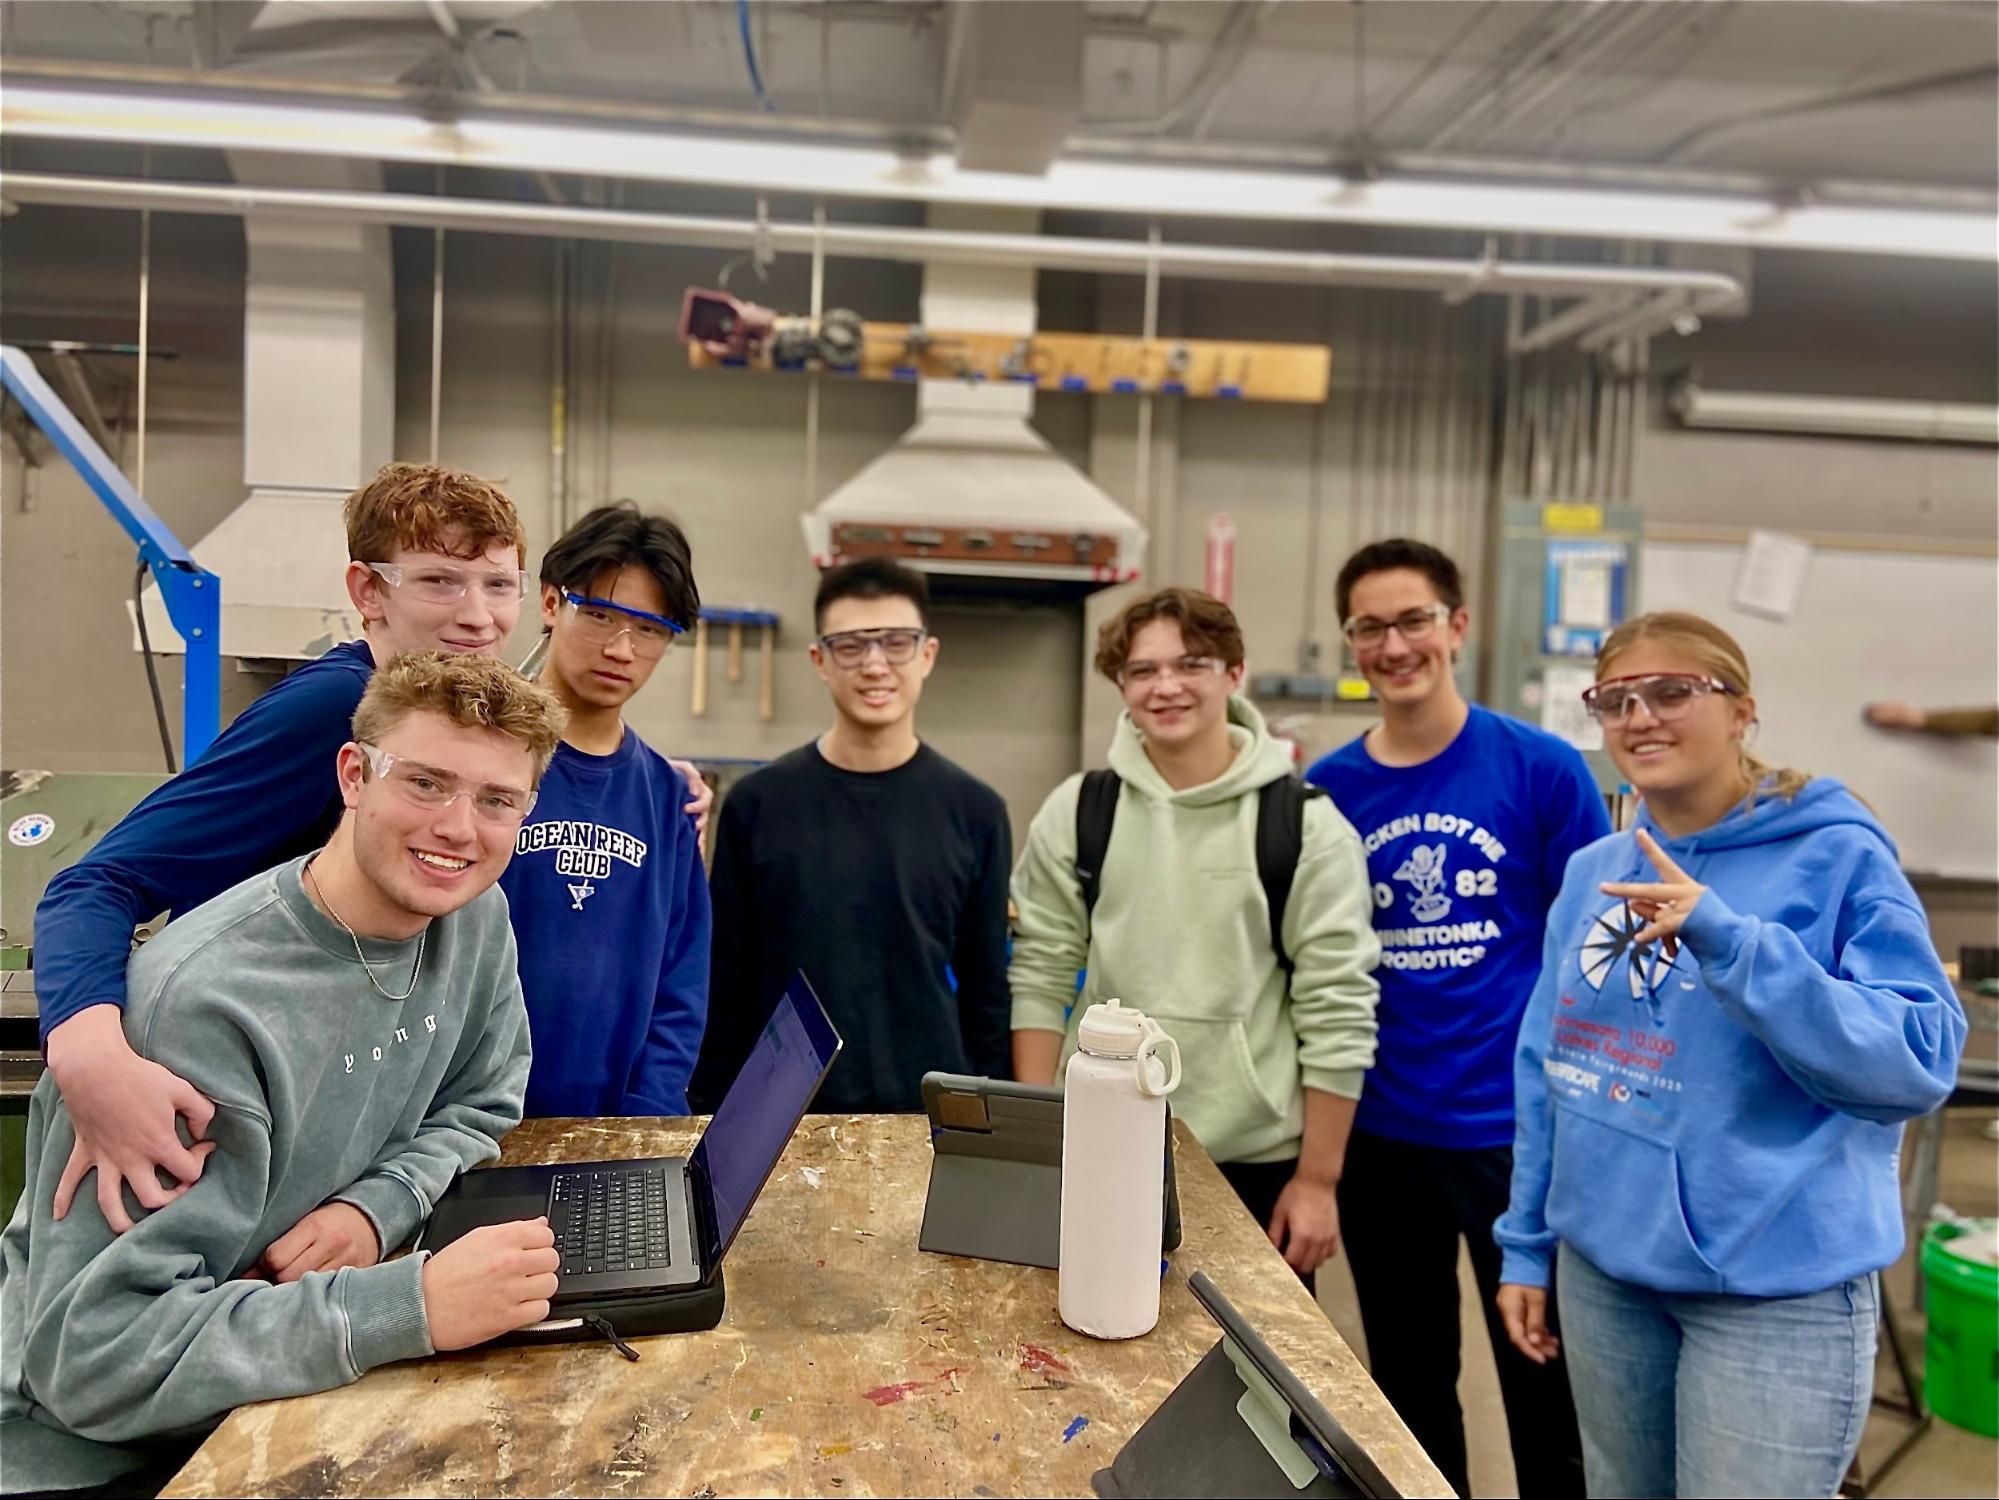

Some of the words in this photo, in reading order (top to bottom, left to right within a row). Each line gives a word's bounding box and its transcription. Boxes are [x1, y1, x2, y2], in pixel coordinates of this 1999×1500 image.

[516, 821, 593, 855] OCEAN
[595, 825, 647, 868] REEF
[1424, 812, 1473, 838] BOT
[1469, 827, 1507, 864] PIE
[556, 848, 611, 878] CLUB
[1455, 868, 1498, 897] 82
